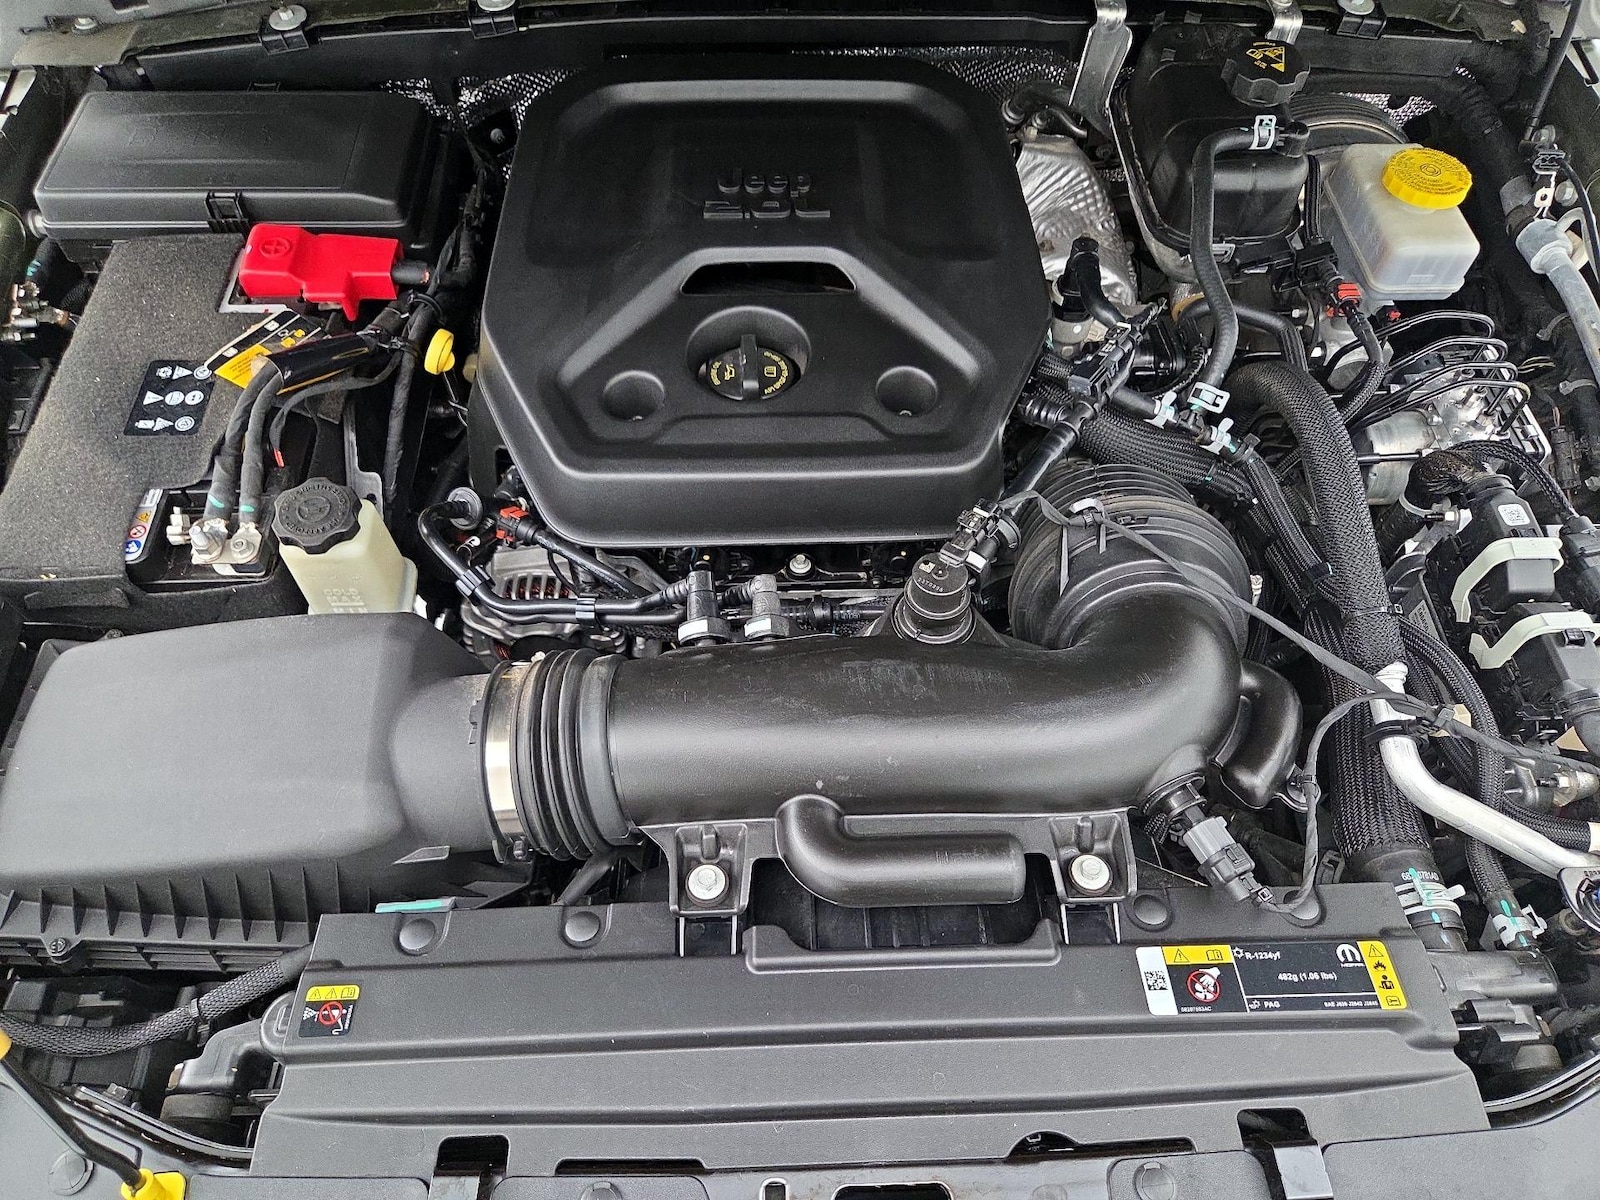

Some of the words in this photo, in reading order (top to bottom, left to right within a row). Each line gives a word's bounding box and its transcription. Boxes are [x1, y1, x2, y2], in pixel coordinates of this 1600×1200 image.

[717, 167, 812, 198] Jeep
[703, 200, 831, 219] 2.0L
[323, 588, 359, 596] COLD
[1244, 951, 1281, 961] R-1234yf
[1277, 972, 1299, 982] 482g
